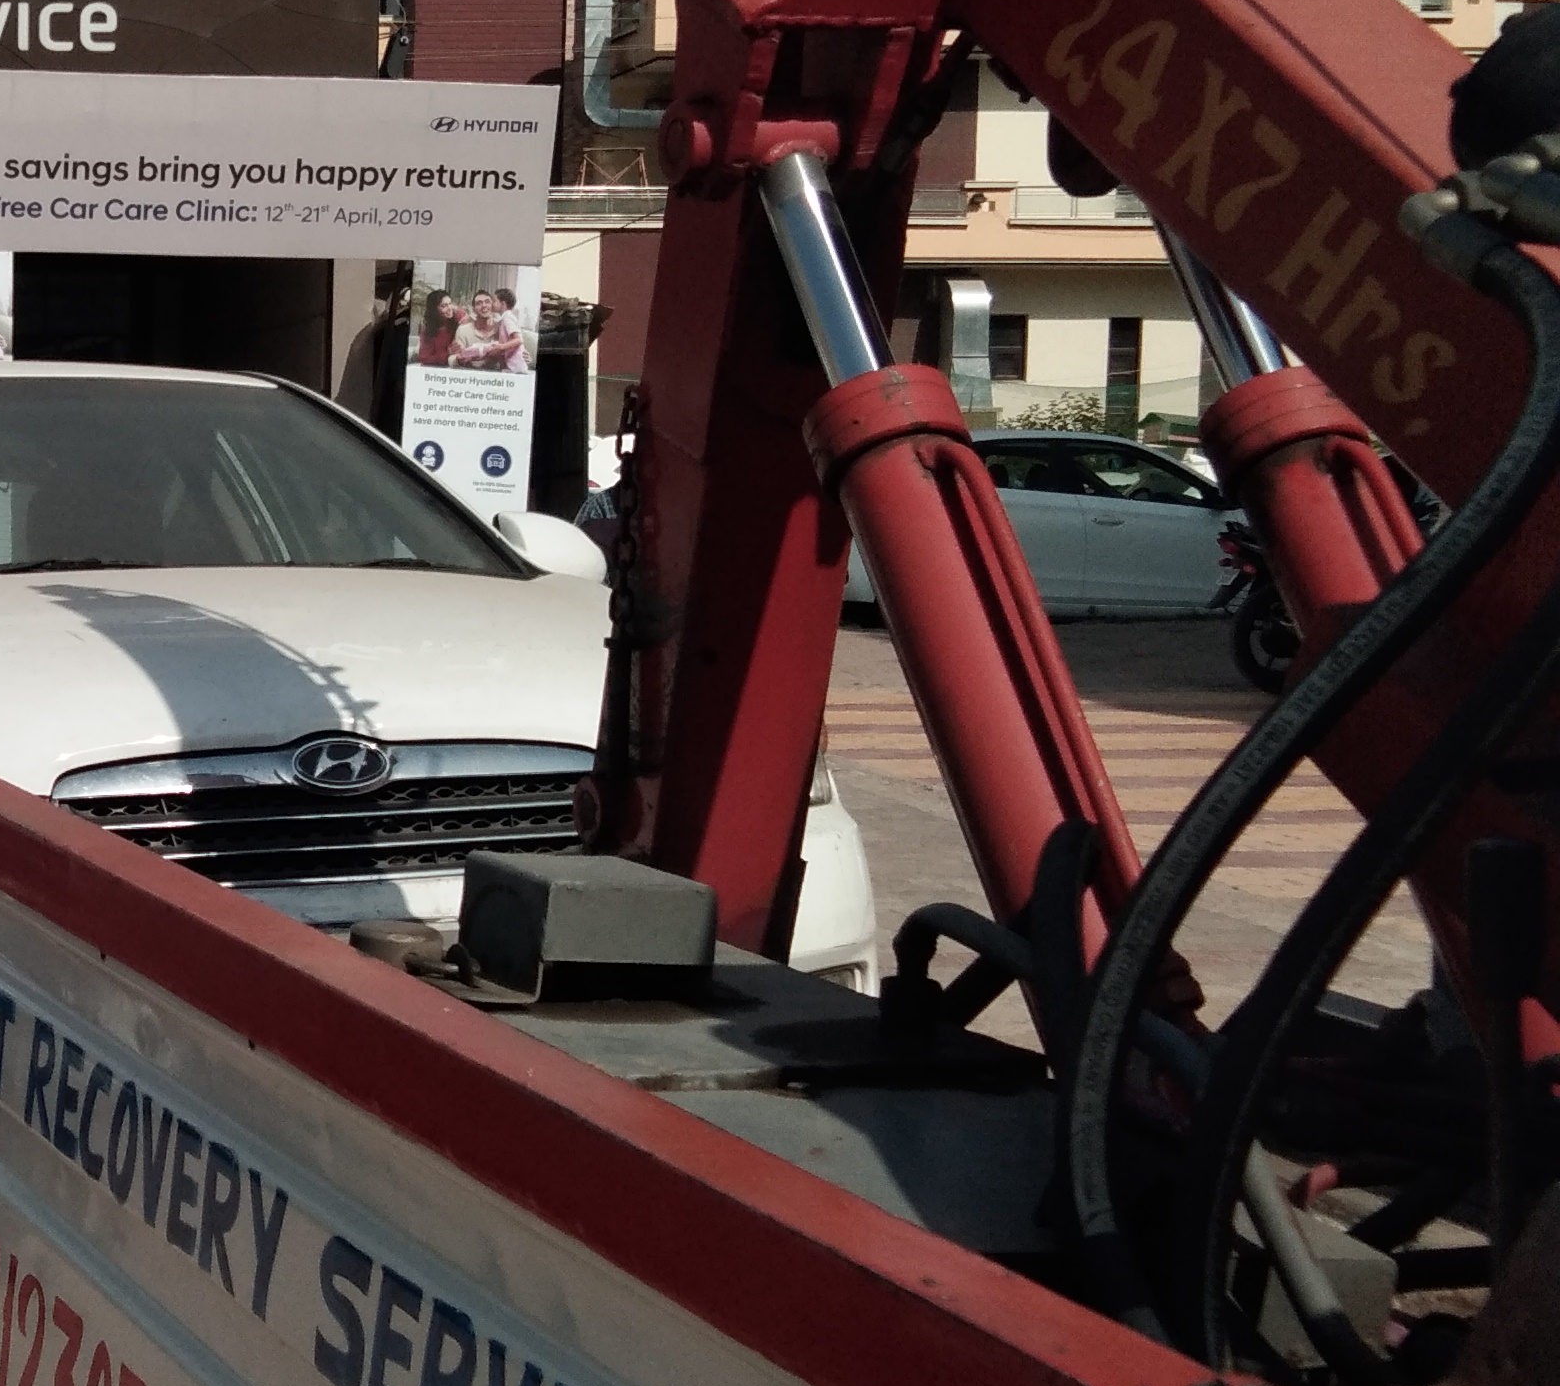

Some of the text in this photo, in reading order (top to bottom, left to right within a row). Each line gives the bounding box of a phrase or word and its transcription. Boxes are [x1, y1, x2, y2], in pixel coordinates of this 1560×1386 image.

[464, 119, 538, 133] HYUNDAI
[4, 153, 129, 187] savings
[138, 155, 221, 189] bring
[229, 164, 286, 189] you
[295, 158, 397, 192] happy
[405, 164, 525, 191] returns.
[50, 198, 98, 221] Car
[104, 199, 168, 221] Care
[175, 199, 257, 223] Clinic:
[333, 206, 382, 227] April,
[387, 209, 433, 226] 2019
[424, 374, 515, 388] Bring your Hyundai to
[428, 388, 509, 402] Free Car Care Clinic
[412, 402, 523, 417] to get attractive offers and
[413, 417, 520, 433] save more than expected.
[23, 1015, 289, 1323] RECOVERY
